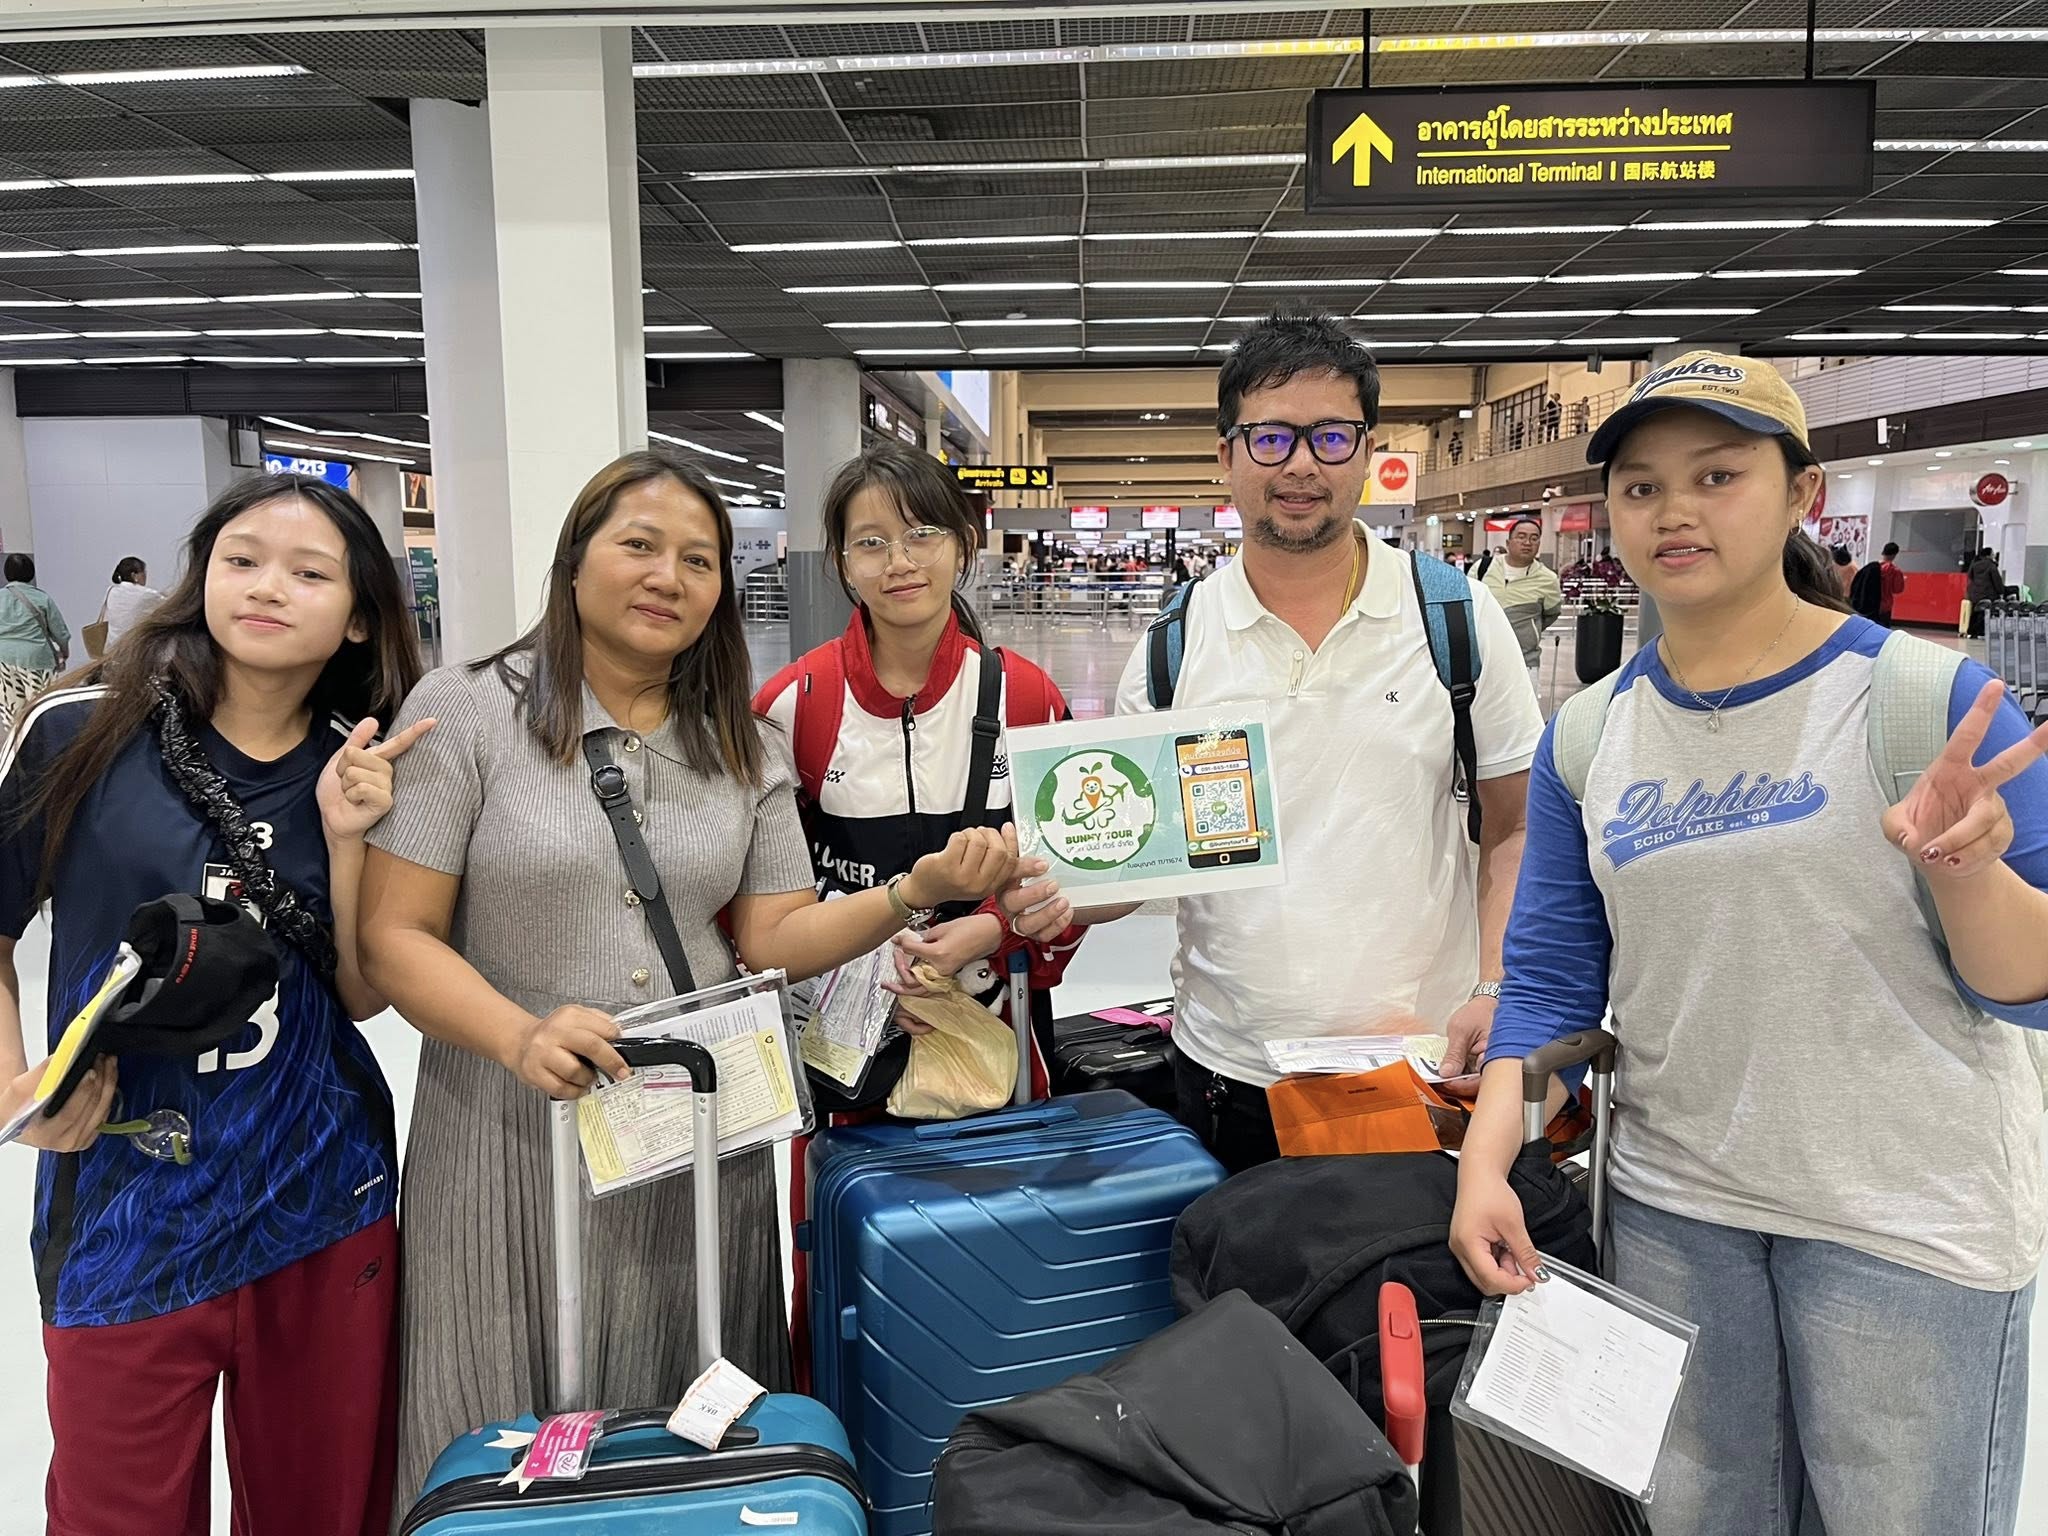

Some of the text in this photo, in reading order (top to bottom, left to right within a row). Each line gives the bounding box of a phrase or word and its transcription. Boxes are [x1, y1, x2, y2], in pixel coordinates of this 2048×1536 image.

[1417, 104, 1733, 150] อาคารผู้โดยสารระหว่างประเทศ
[1416, 161, 1603, 185] International Terminal
[1623, 160, 1716, 181] 国际航站楼
[1629, 356, 1744, 402] Yankees
[1399, 508, 1405, 519] 1
[1615, 770, 1814, 832] Dolphins
[1105, 830, 1133, 840] TOUR
[1633, 830, 1676, 851] ECHO
[1685, 820, 1724, 836] LAKE
